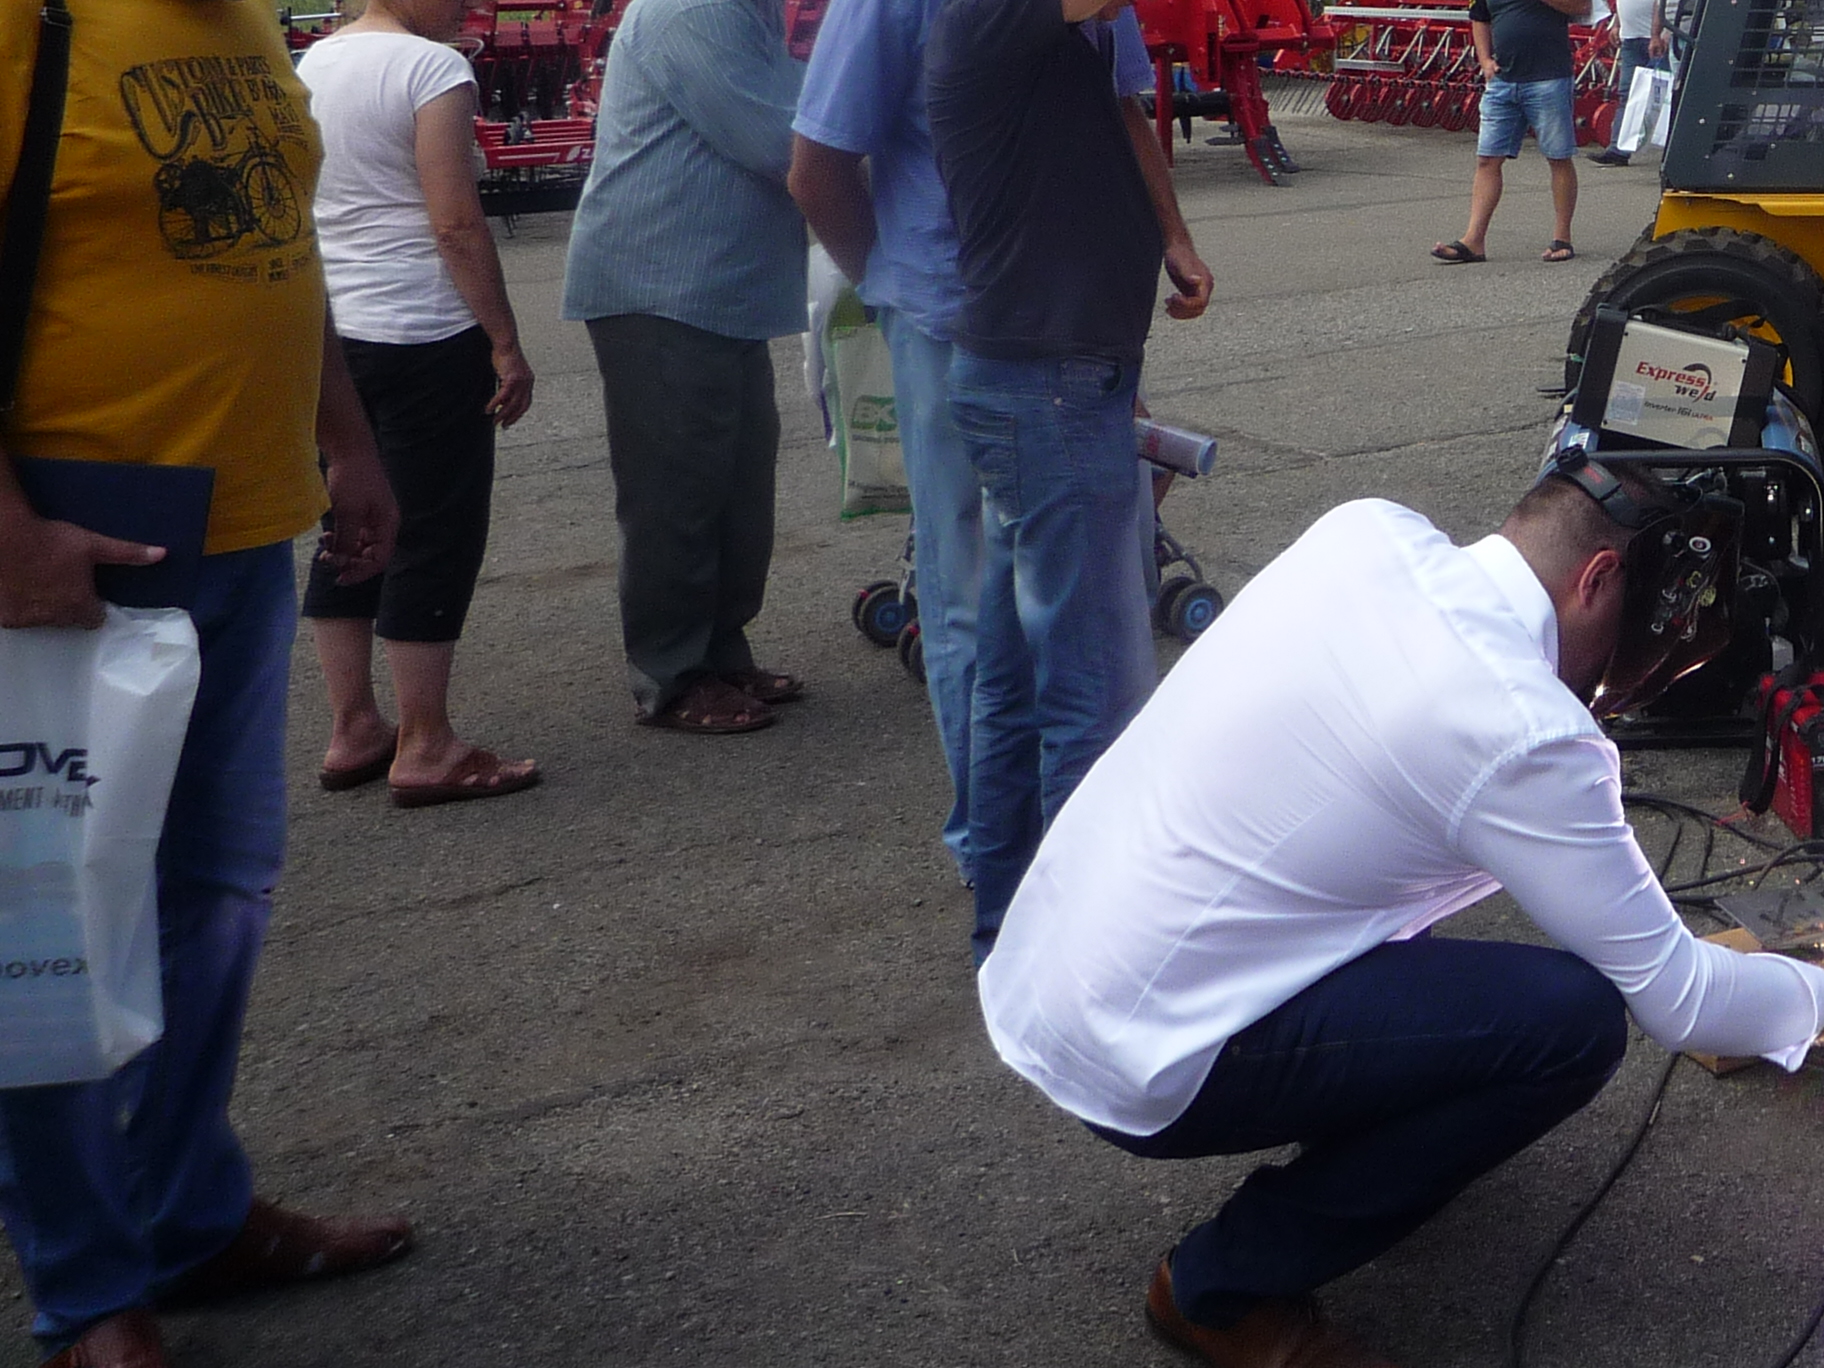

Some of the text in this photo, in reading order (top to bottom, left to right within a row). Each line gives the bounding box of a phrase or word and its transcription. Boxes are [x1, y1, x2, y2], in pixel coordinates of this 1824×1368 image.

[1635, 360, 1708, 388] Express
[1674, 384, 1717, 404] weld
[0, 958, 89, 979] ovex
